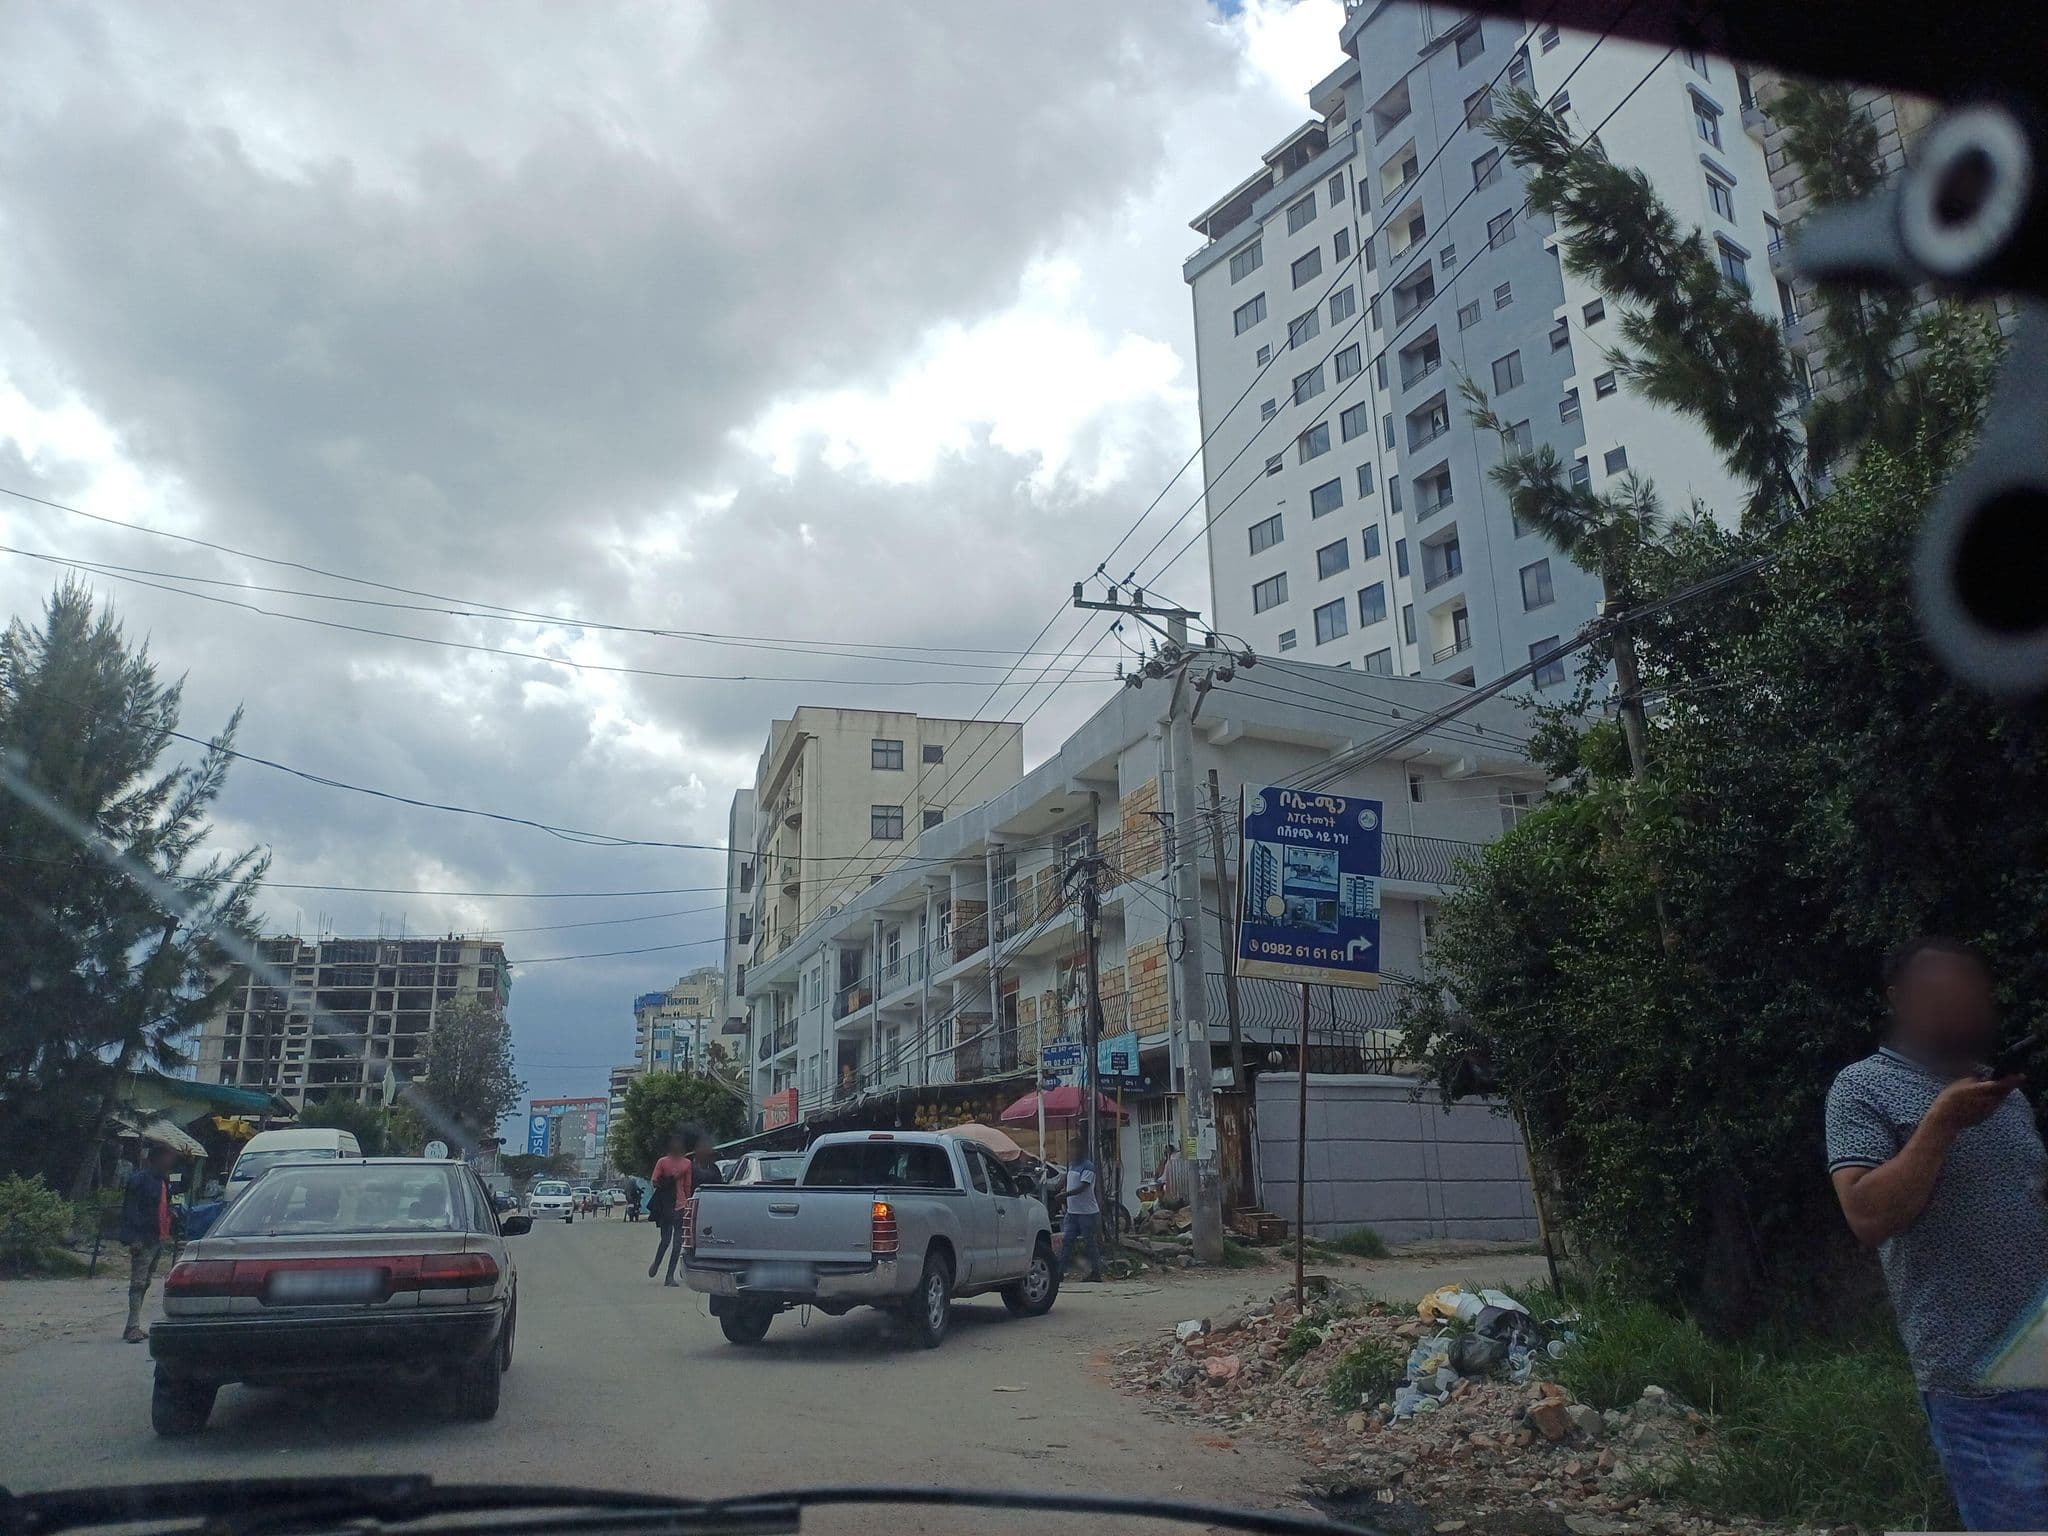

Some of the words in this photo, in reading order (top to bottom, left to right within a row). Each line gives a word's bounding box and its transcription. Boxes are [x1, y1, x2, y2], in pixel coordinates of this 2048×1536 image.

[1316, 831, 1331, 842] ላይ
[1261, 942, 1293, 956] 0982
[1295, 946, 1310, 958] 61
[1313, 948, 1327, 960] 61
[1330, 950, 1345, 962] 61
[1062, 1058, 1072, 1066] 247
[532, 1134, 545, 1157] psi
